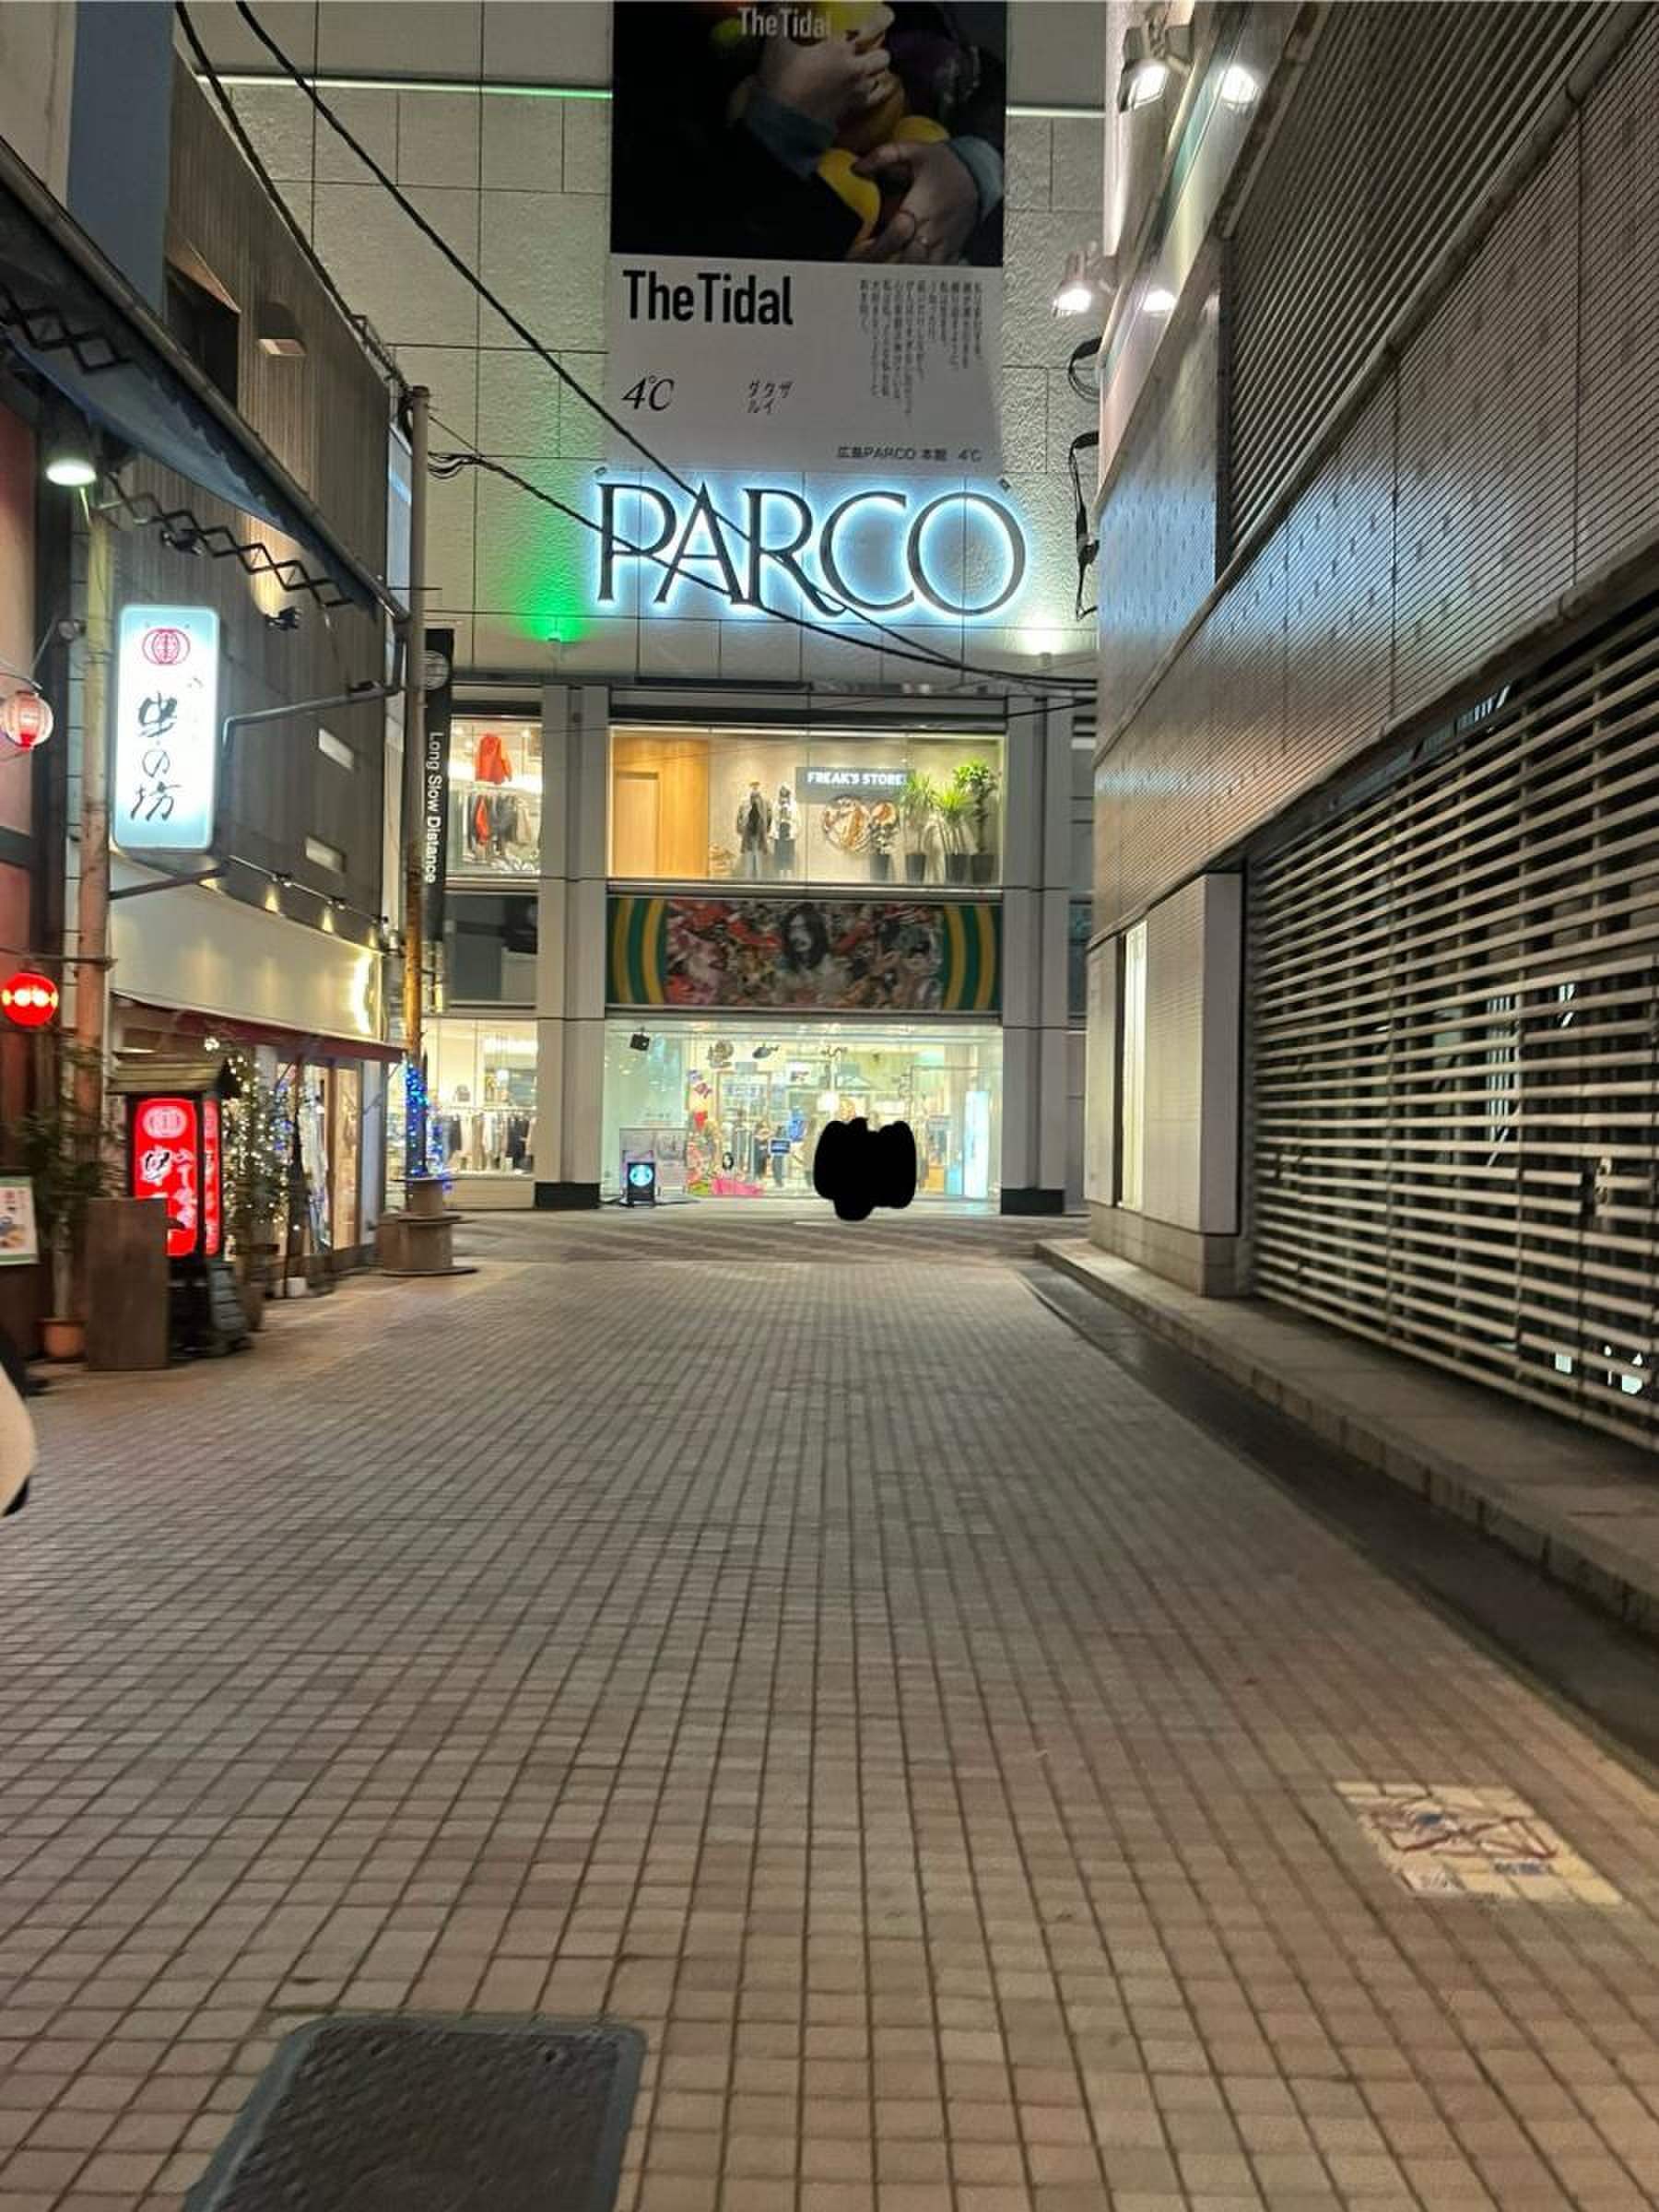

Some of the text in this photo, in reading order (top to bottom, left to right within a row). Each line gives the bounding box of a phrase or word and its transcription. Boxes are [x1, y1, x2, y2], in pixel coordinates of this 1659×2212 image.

[597, 480, 1027, 618] PARCO
[424, 731, 443, 885] Long Slow Distance
[807, 771, 907, 785] FREAK'S STORE
